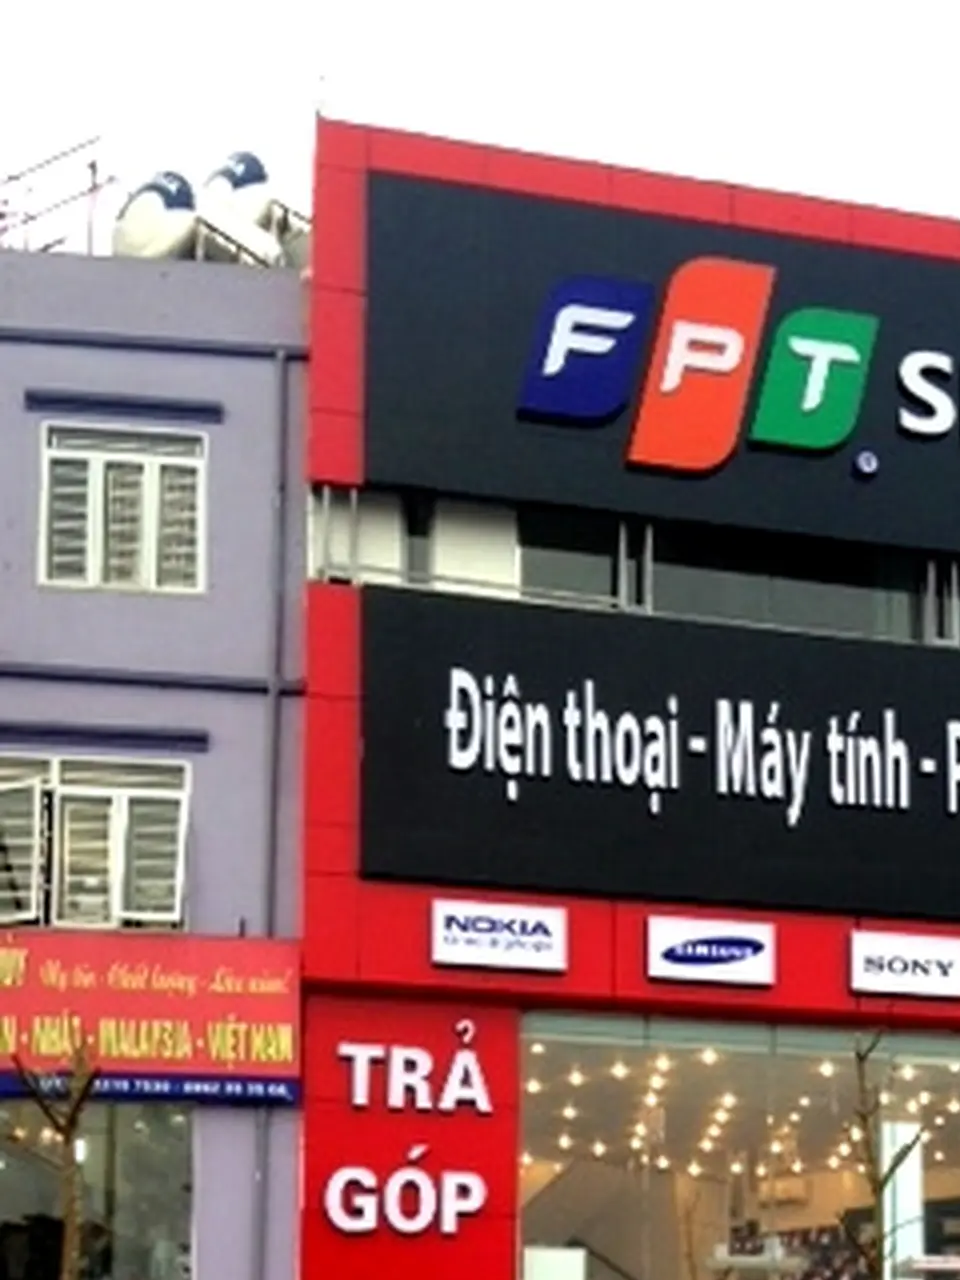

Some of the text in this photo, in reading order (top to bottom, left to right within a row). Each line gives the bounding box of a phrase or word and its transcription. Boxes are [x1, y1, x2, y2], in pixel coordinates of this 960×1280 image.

[541, 302, 862, 413] FPT
[445, 667, 552, 801] Điện
[563, 678, 680, 815] thoại
[715, 697, 811, 827] Máy
[826, 711, 909, 810] tính
[443, 913, 553, 938] NOKIA
[864, 954, 954, 978] SONY
[206, 1012, 248, 1071] VIỆT
[250, 1022, 294, 1064] NAM
[336, 1018, 494, 1113] TRẢ
[324, 1143, 489, 1234] GÓP
